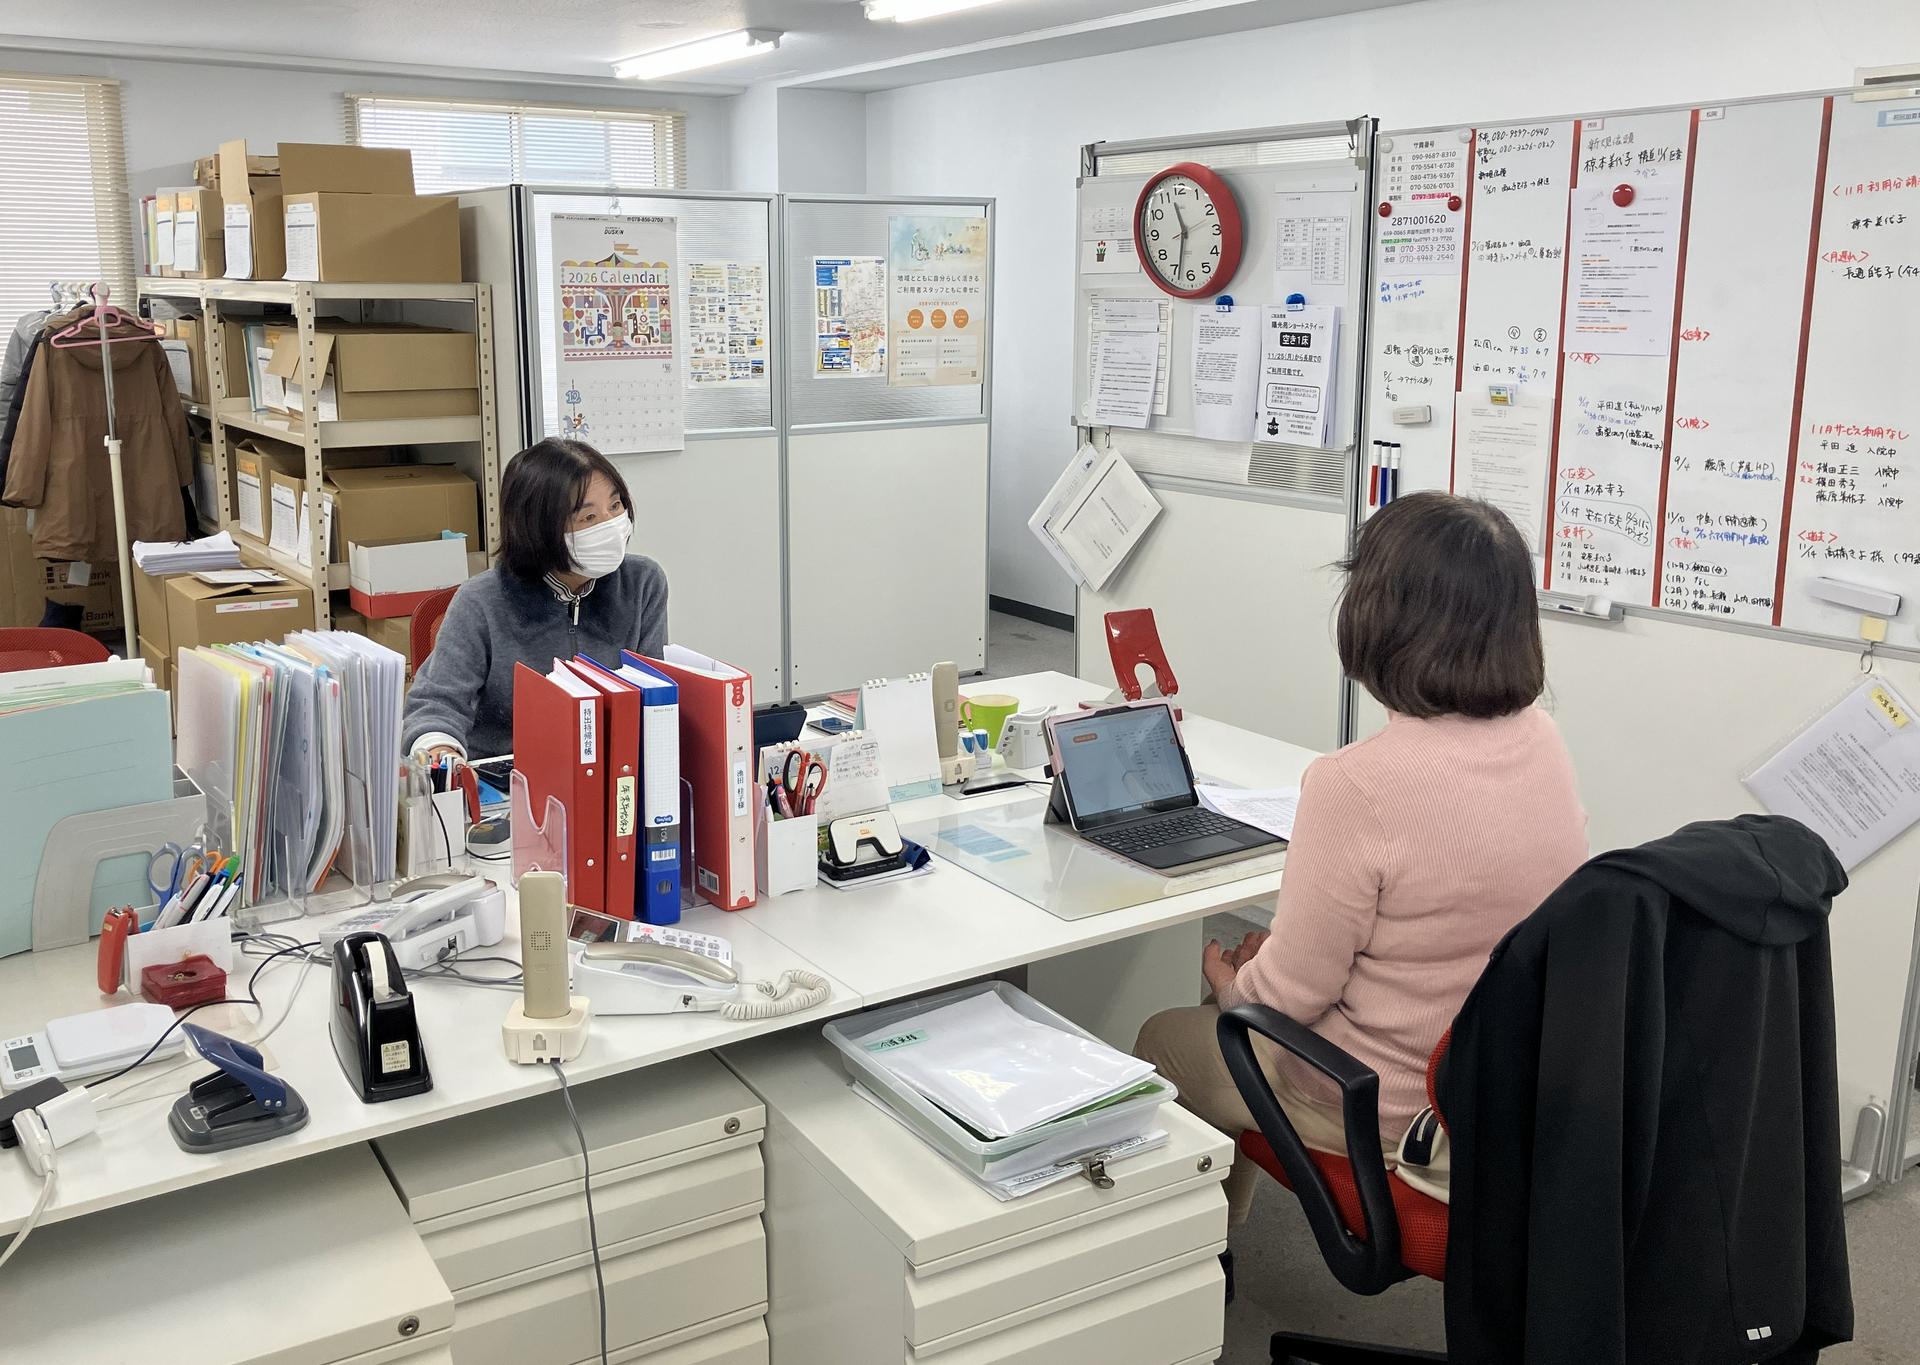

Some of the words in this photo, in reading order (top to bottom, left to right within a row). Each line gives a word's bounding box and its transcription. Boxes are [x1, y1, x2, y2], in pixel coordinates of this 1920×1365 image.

[1174, 183, 1186, 196] 12
[1832, 175, 1920, 196] <11月利用分請
[1160, 192, 1171, 204] 11
[1195, 189, 1199, 200] 1
[1151, 209, 1164, 221] 10
[1205, 204, 1214, 216] 2
[1392, 214, 1447, 226] 2871001620
[1151, 230, 1159, 241] 9
[1212, 224, 1221, 236] 3
[1210, 245, 1220, 256] 4
[1400, 244, 1456, 253] 070-3053-2530
[1158, 249, 1168, 261] 8
[1170, 264, 1179, 275] 7
[1201, 262, 1211, 274] 5
[568, 272, 598, 284] 2026
[600, 270, 662, 284] Calendar
[1186, 270, 1196, 281] 6
[1282, 334, 1309, 345] 空き1床
